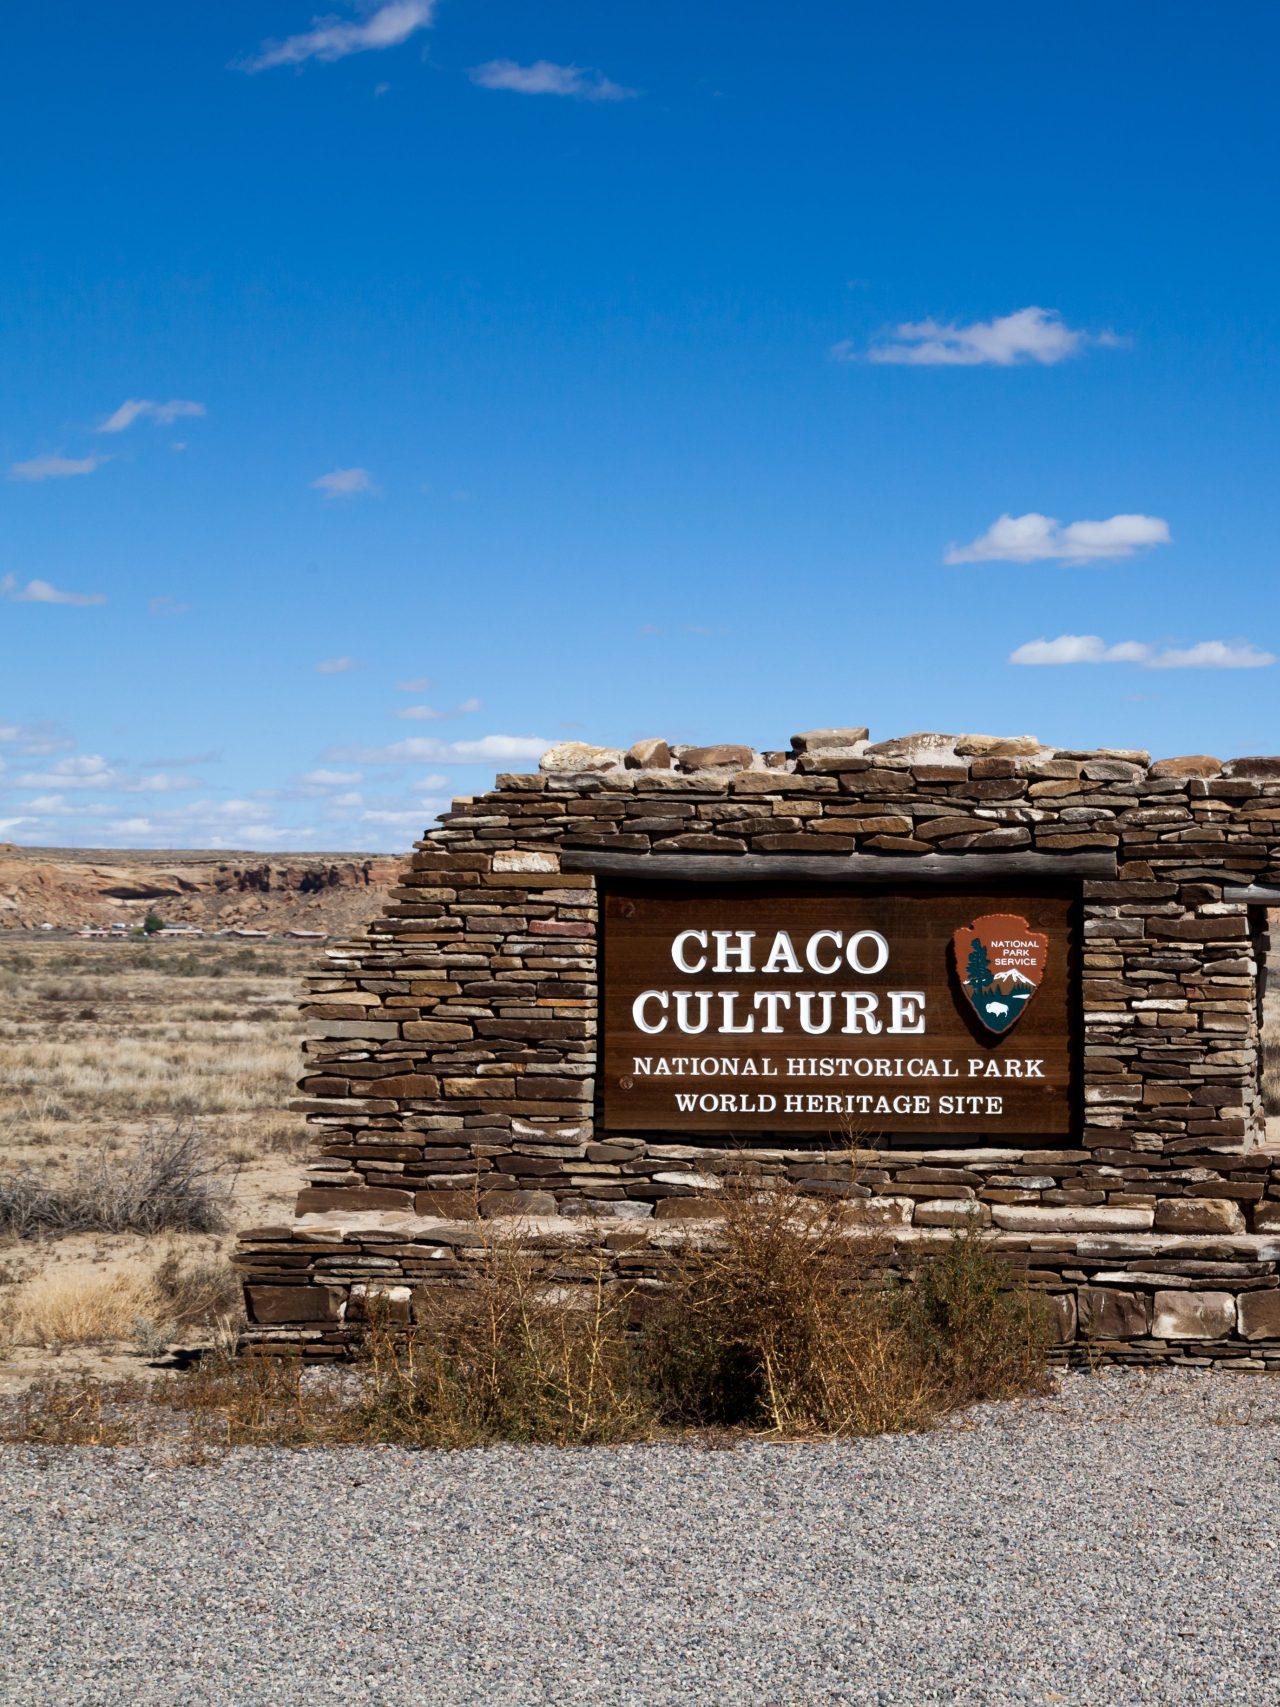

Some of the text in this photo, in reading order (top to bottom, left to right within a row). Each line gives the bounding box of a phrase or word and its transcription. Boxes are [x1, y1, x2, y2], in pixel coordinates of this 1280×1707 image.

[671, 929, 890, 975] CHACO
[991, 940, 1040, 948] NATIONAL
[1002, 949, 1030, 957] PARK
[994, 958, 1038, 966] SERVICE
[631, 989, 926, 1035] CULTURE
[632, 1056, 1046, 1078] NATIONAL HISTORICAL PARK
[674, 1093, 1003, 1115] WORLD HERITAGE SITE
